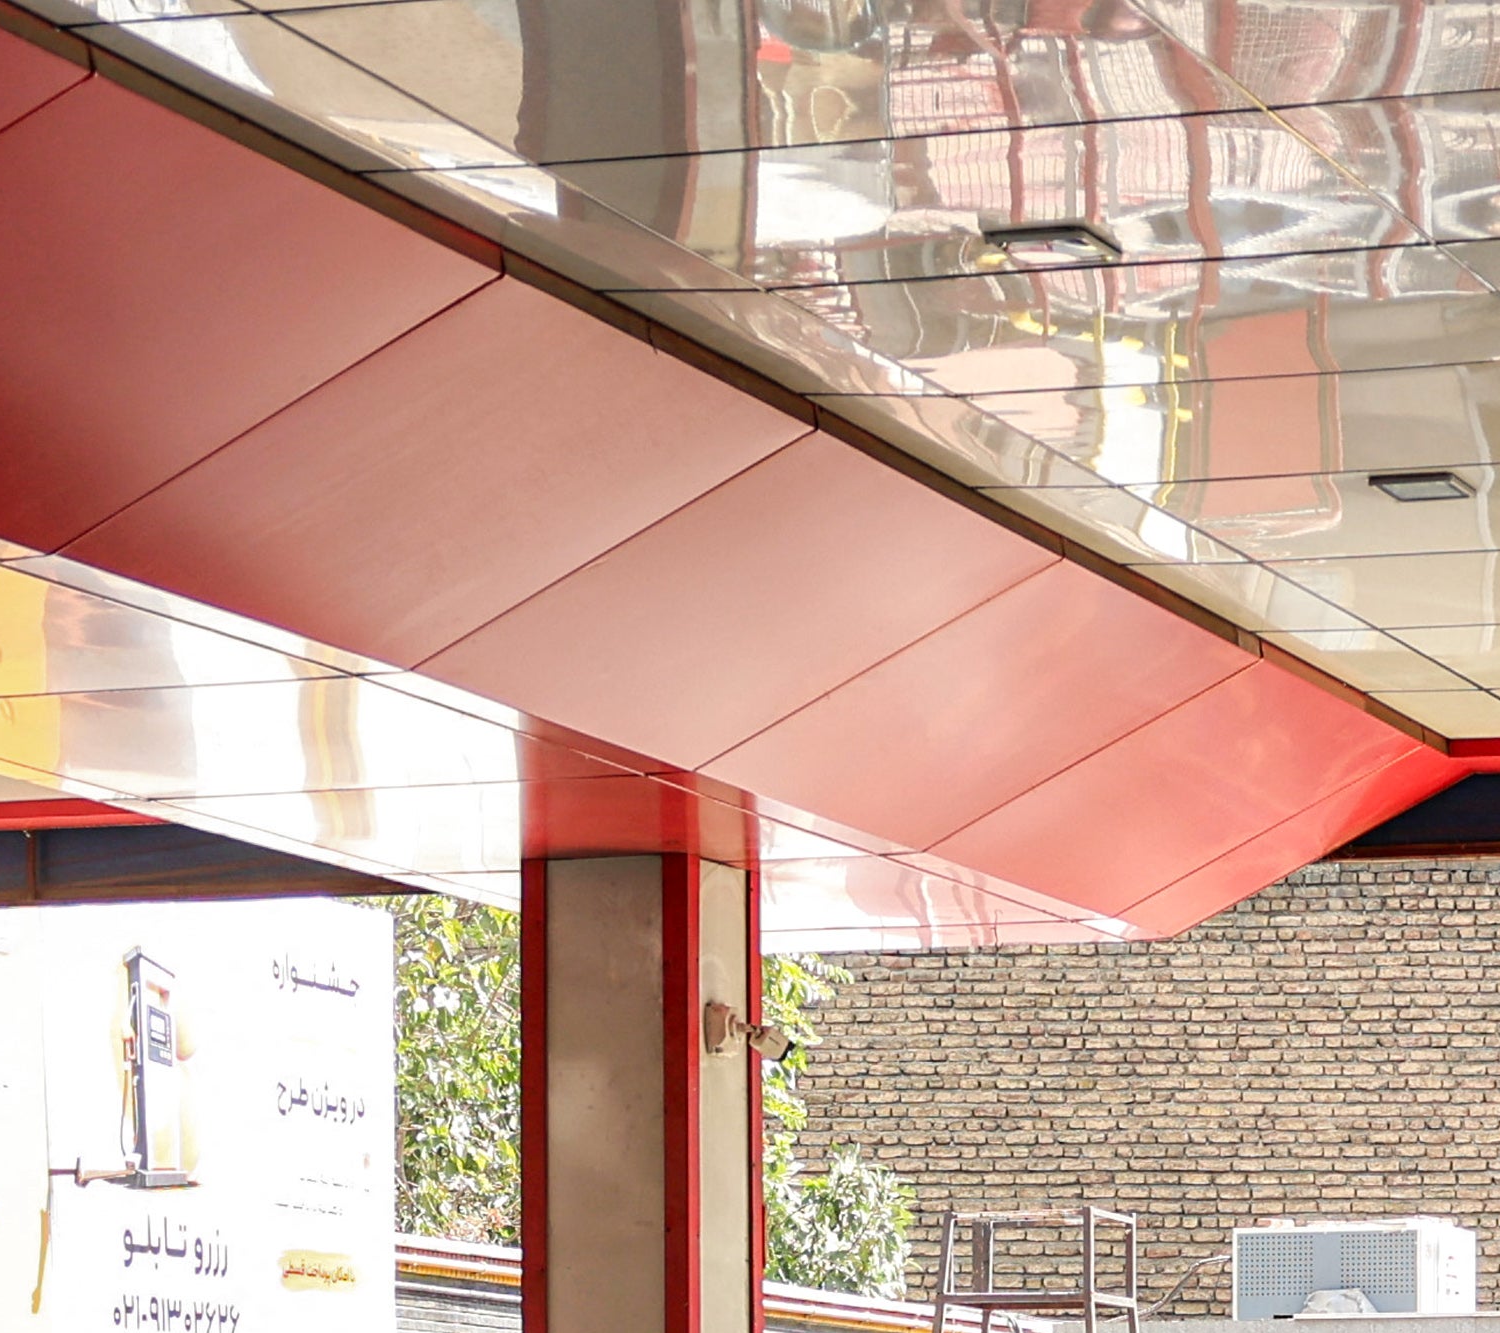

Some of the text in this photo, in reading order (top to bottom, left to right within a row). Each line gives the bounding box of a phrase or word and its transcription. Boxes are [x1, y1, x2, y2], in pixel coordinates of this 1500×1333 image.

[272, 952, 360, 1007] جشنواره
[277, 1077, 308, 1116] طرح
[123, 1214, 228, 1278] رزرو تابلو
